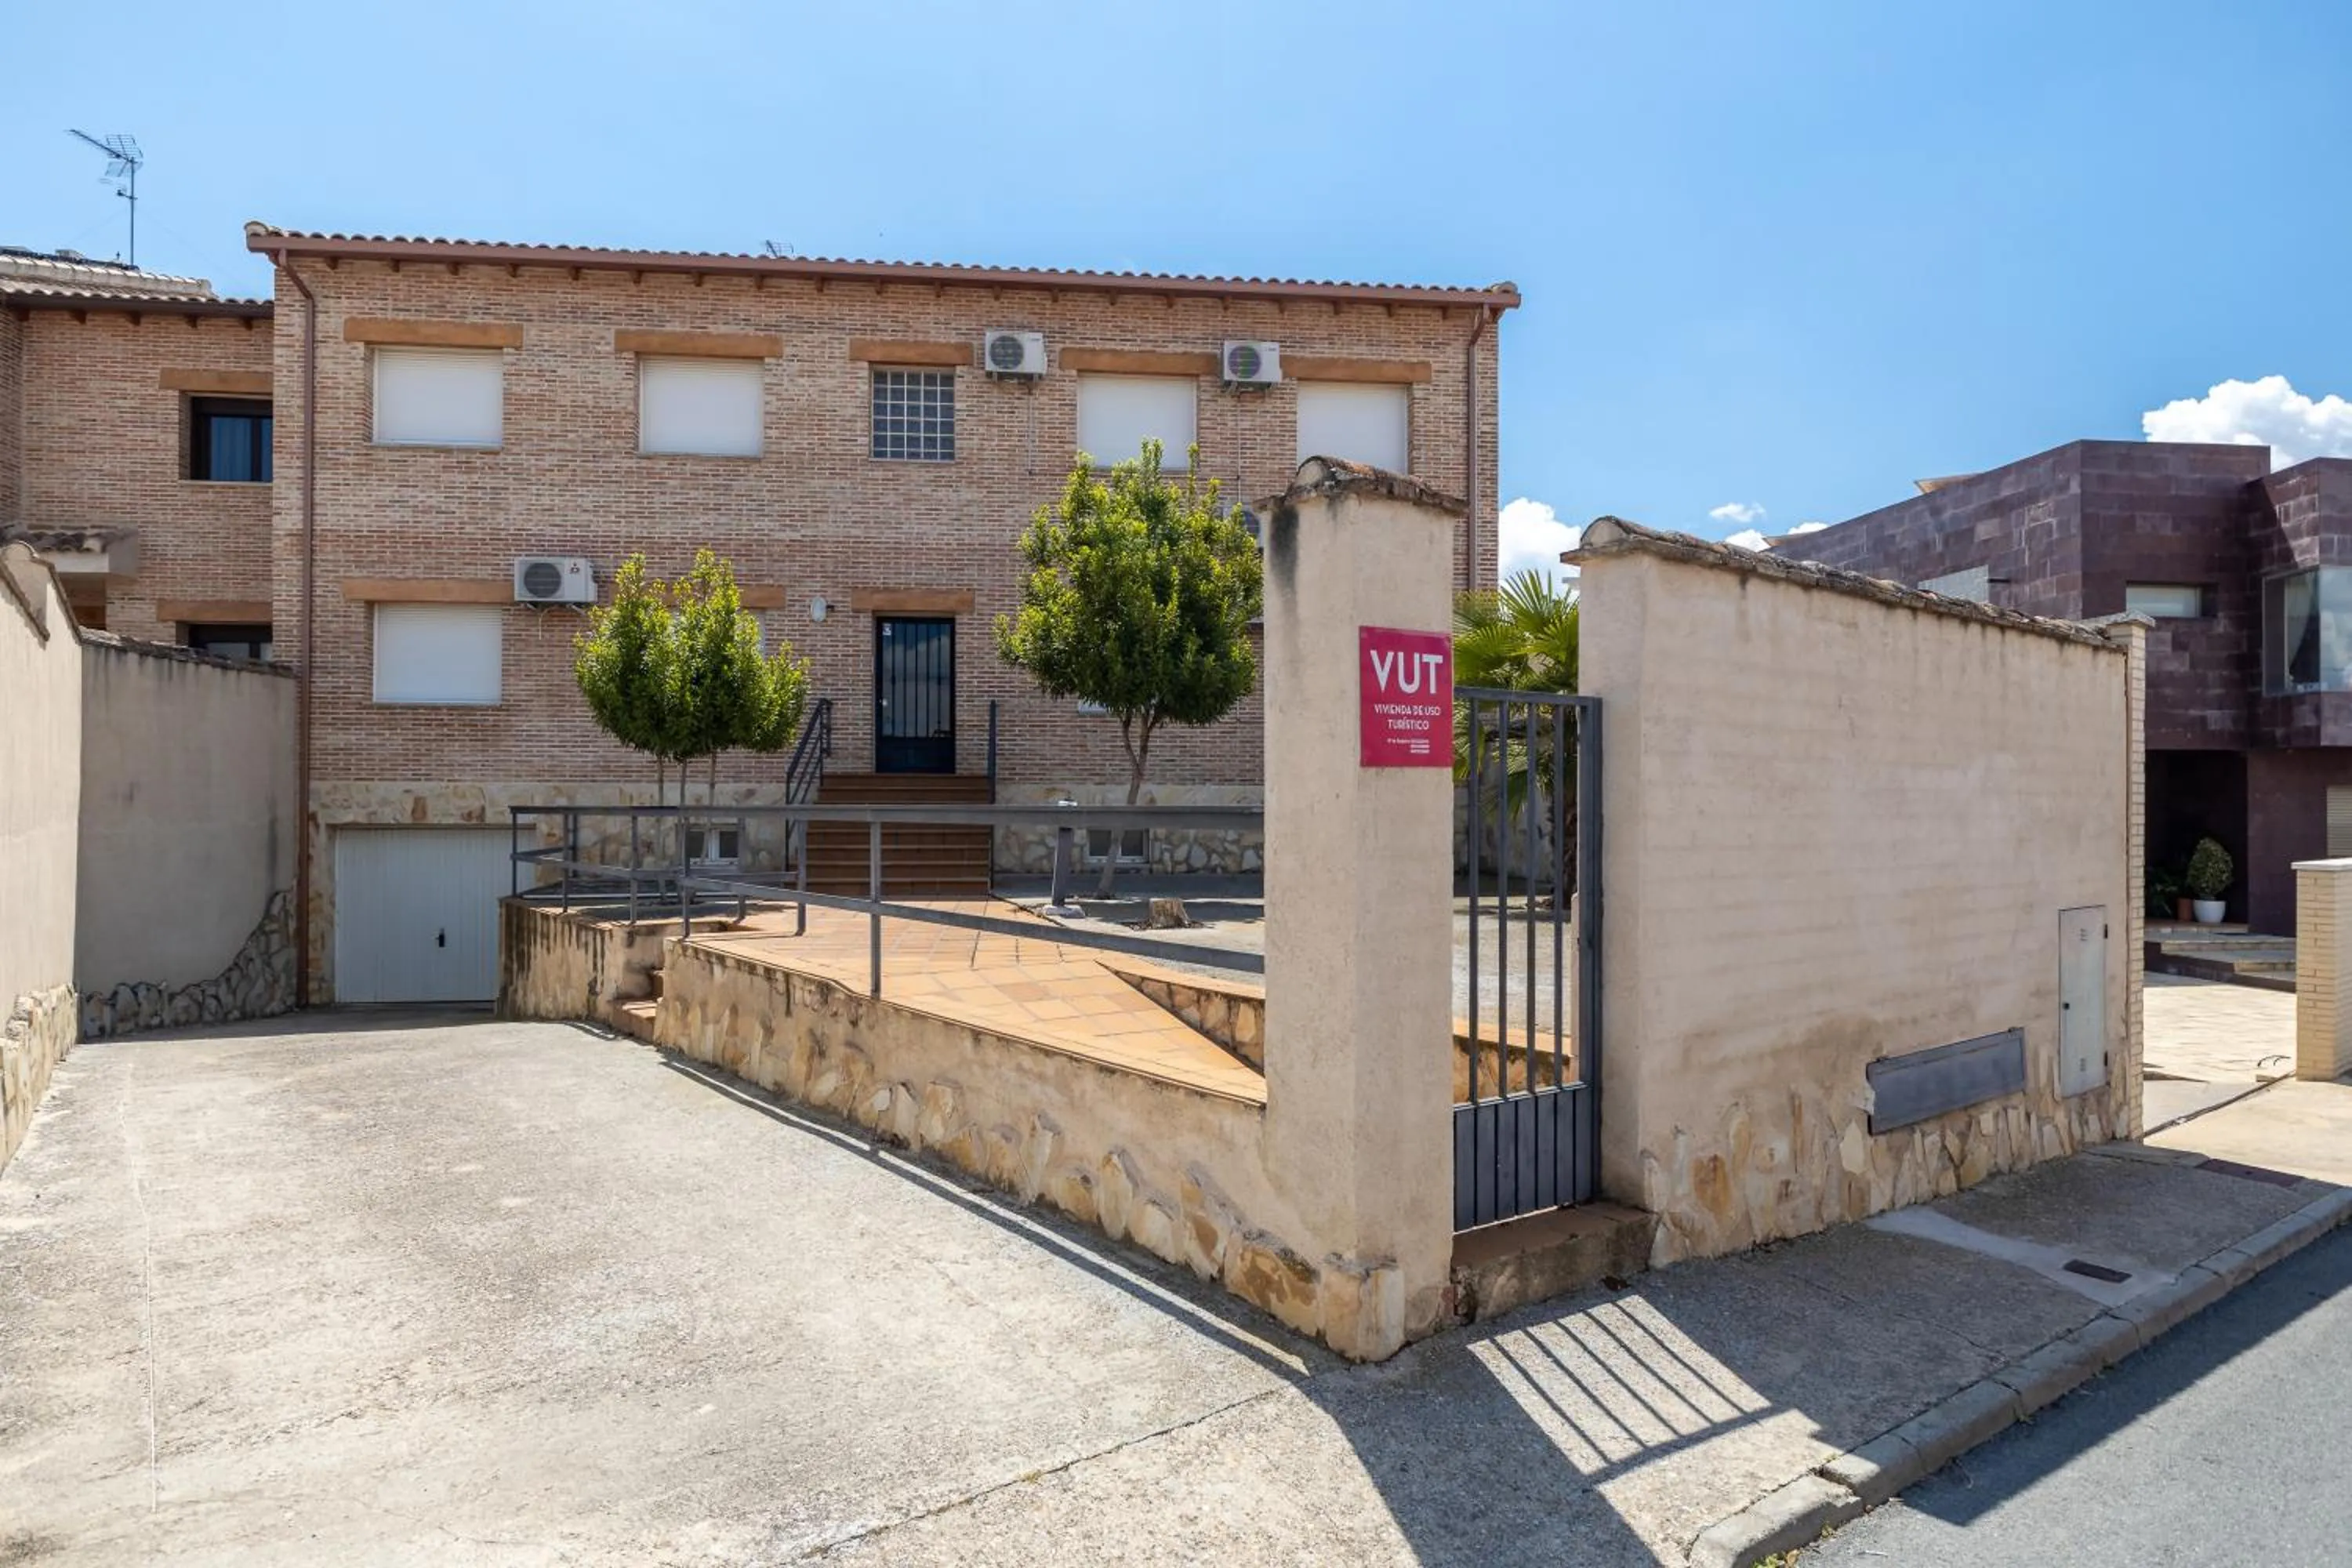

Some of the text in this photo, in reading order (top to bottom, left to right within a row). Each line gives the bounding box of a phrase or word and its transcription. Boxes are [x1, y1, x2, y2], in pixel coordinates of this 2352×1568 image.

[1370, 649, 1443, 694] VUT
[1374, 704, 1440, 716] VIVIENDA DE USO
[1388, 717, 1429, 730] TURÍSTICO
